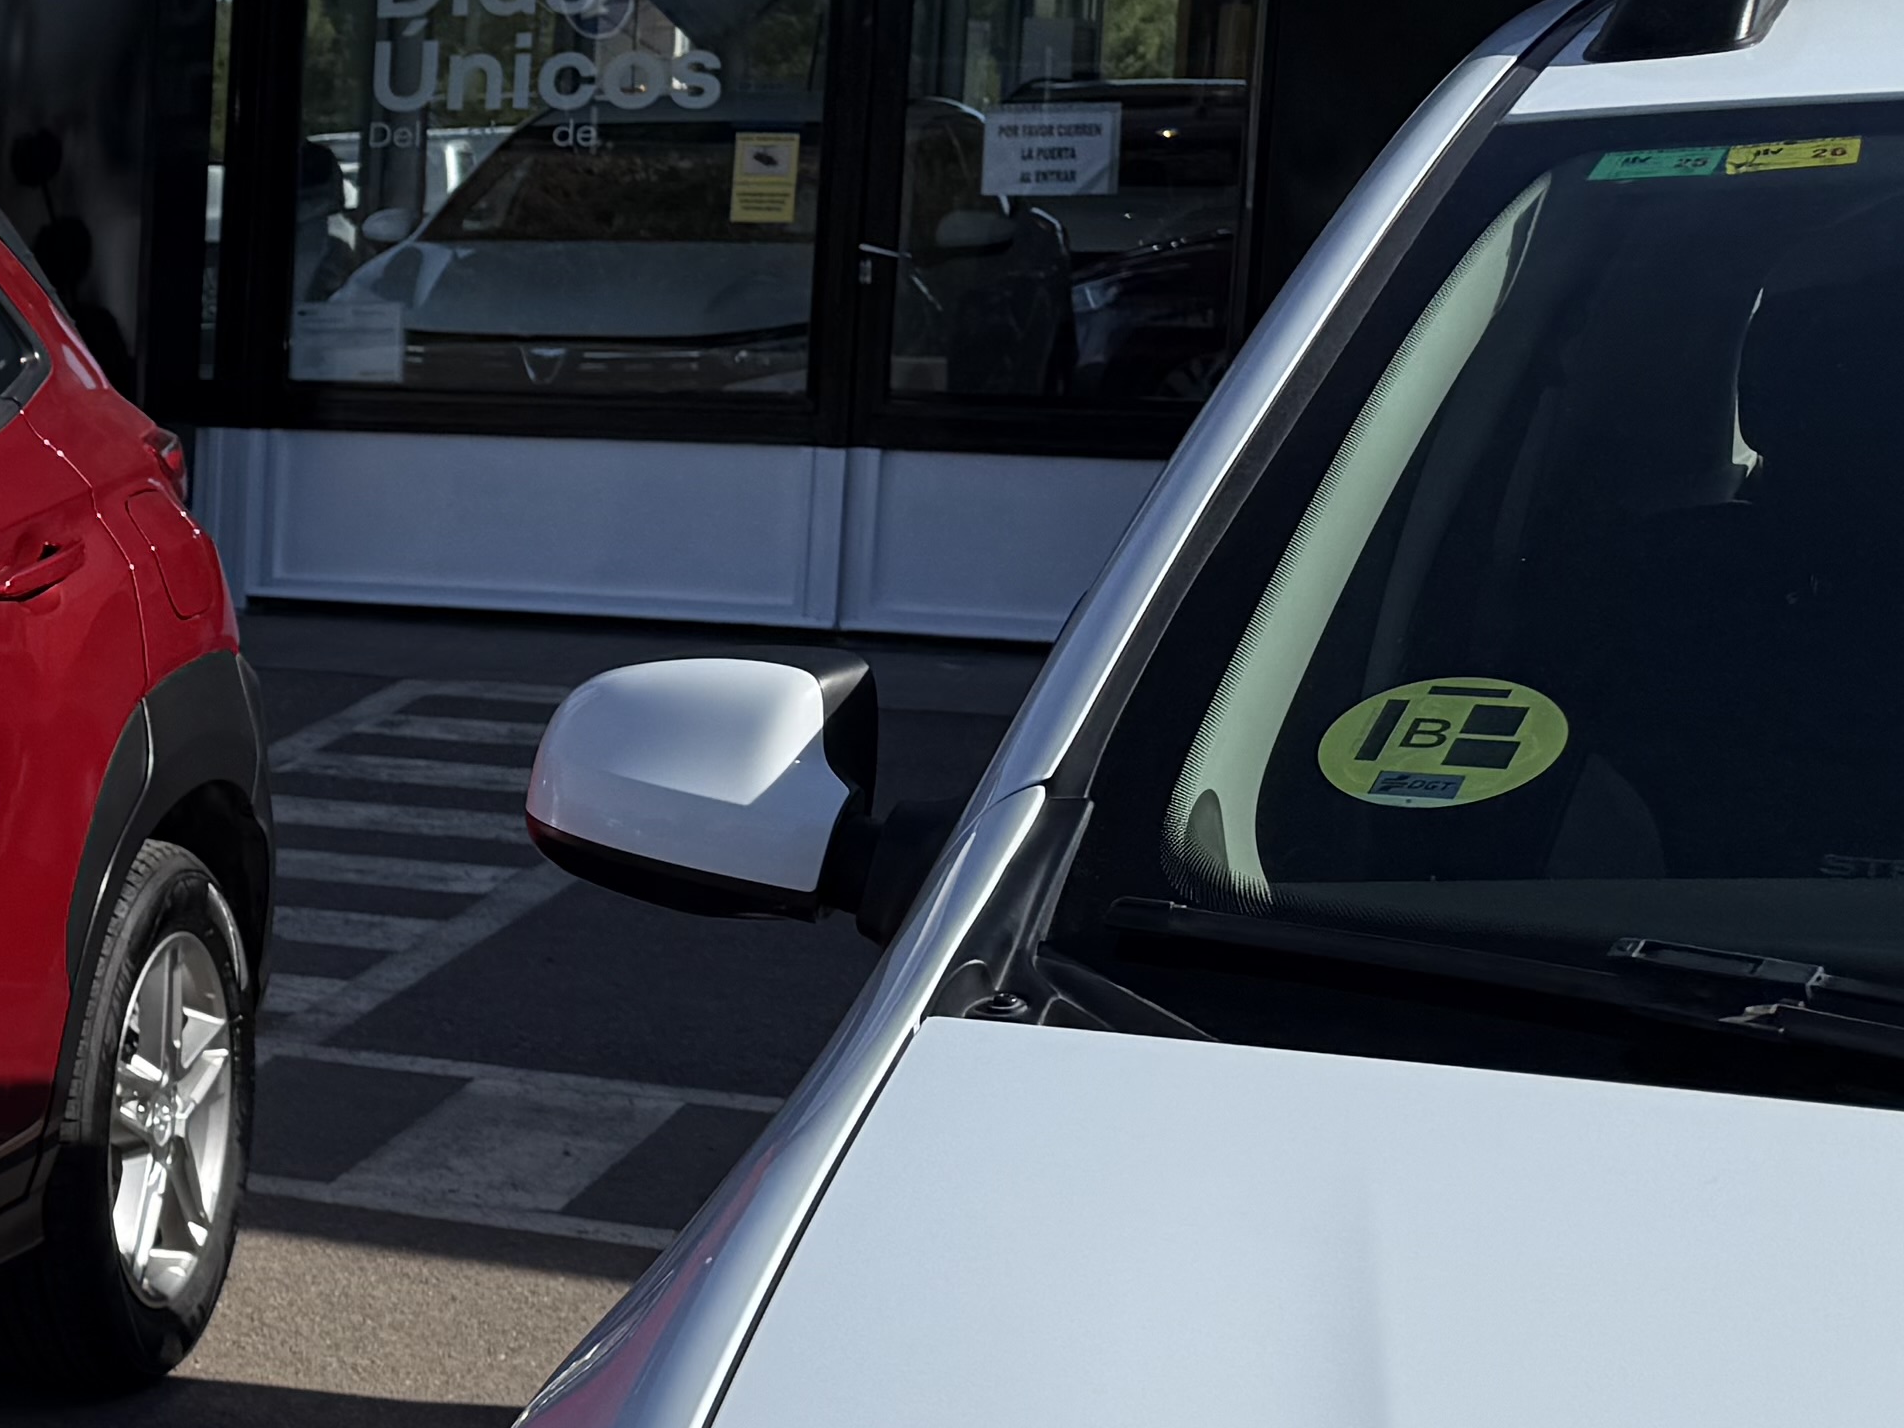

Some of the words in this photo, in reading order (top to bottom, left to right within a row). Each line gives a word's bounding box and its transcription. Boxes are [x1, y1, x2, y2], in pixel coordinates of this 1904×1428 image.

[373, 18, 722, 112] Únicos
[369, 121, 420, 149] Del
[998, 123, 1020, 138] POR
[1022, 123, 1055, 137] FAVOR
[1057, 123, 1102, 138] CIERREN
[1021, 147, 1034, 161] LA
[1036, 146, 1077, 161] PUERTA
[1020, 171, 1032, 184] AL
[1035, 170, 1077, 184] ENTRAR
[1398, 717, 1452, 749] B
[1407, 778, 1456, 791] DGT
